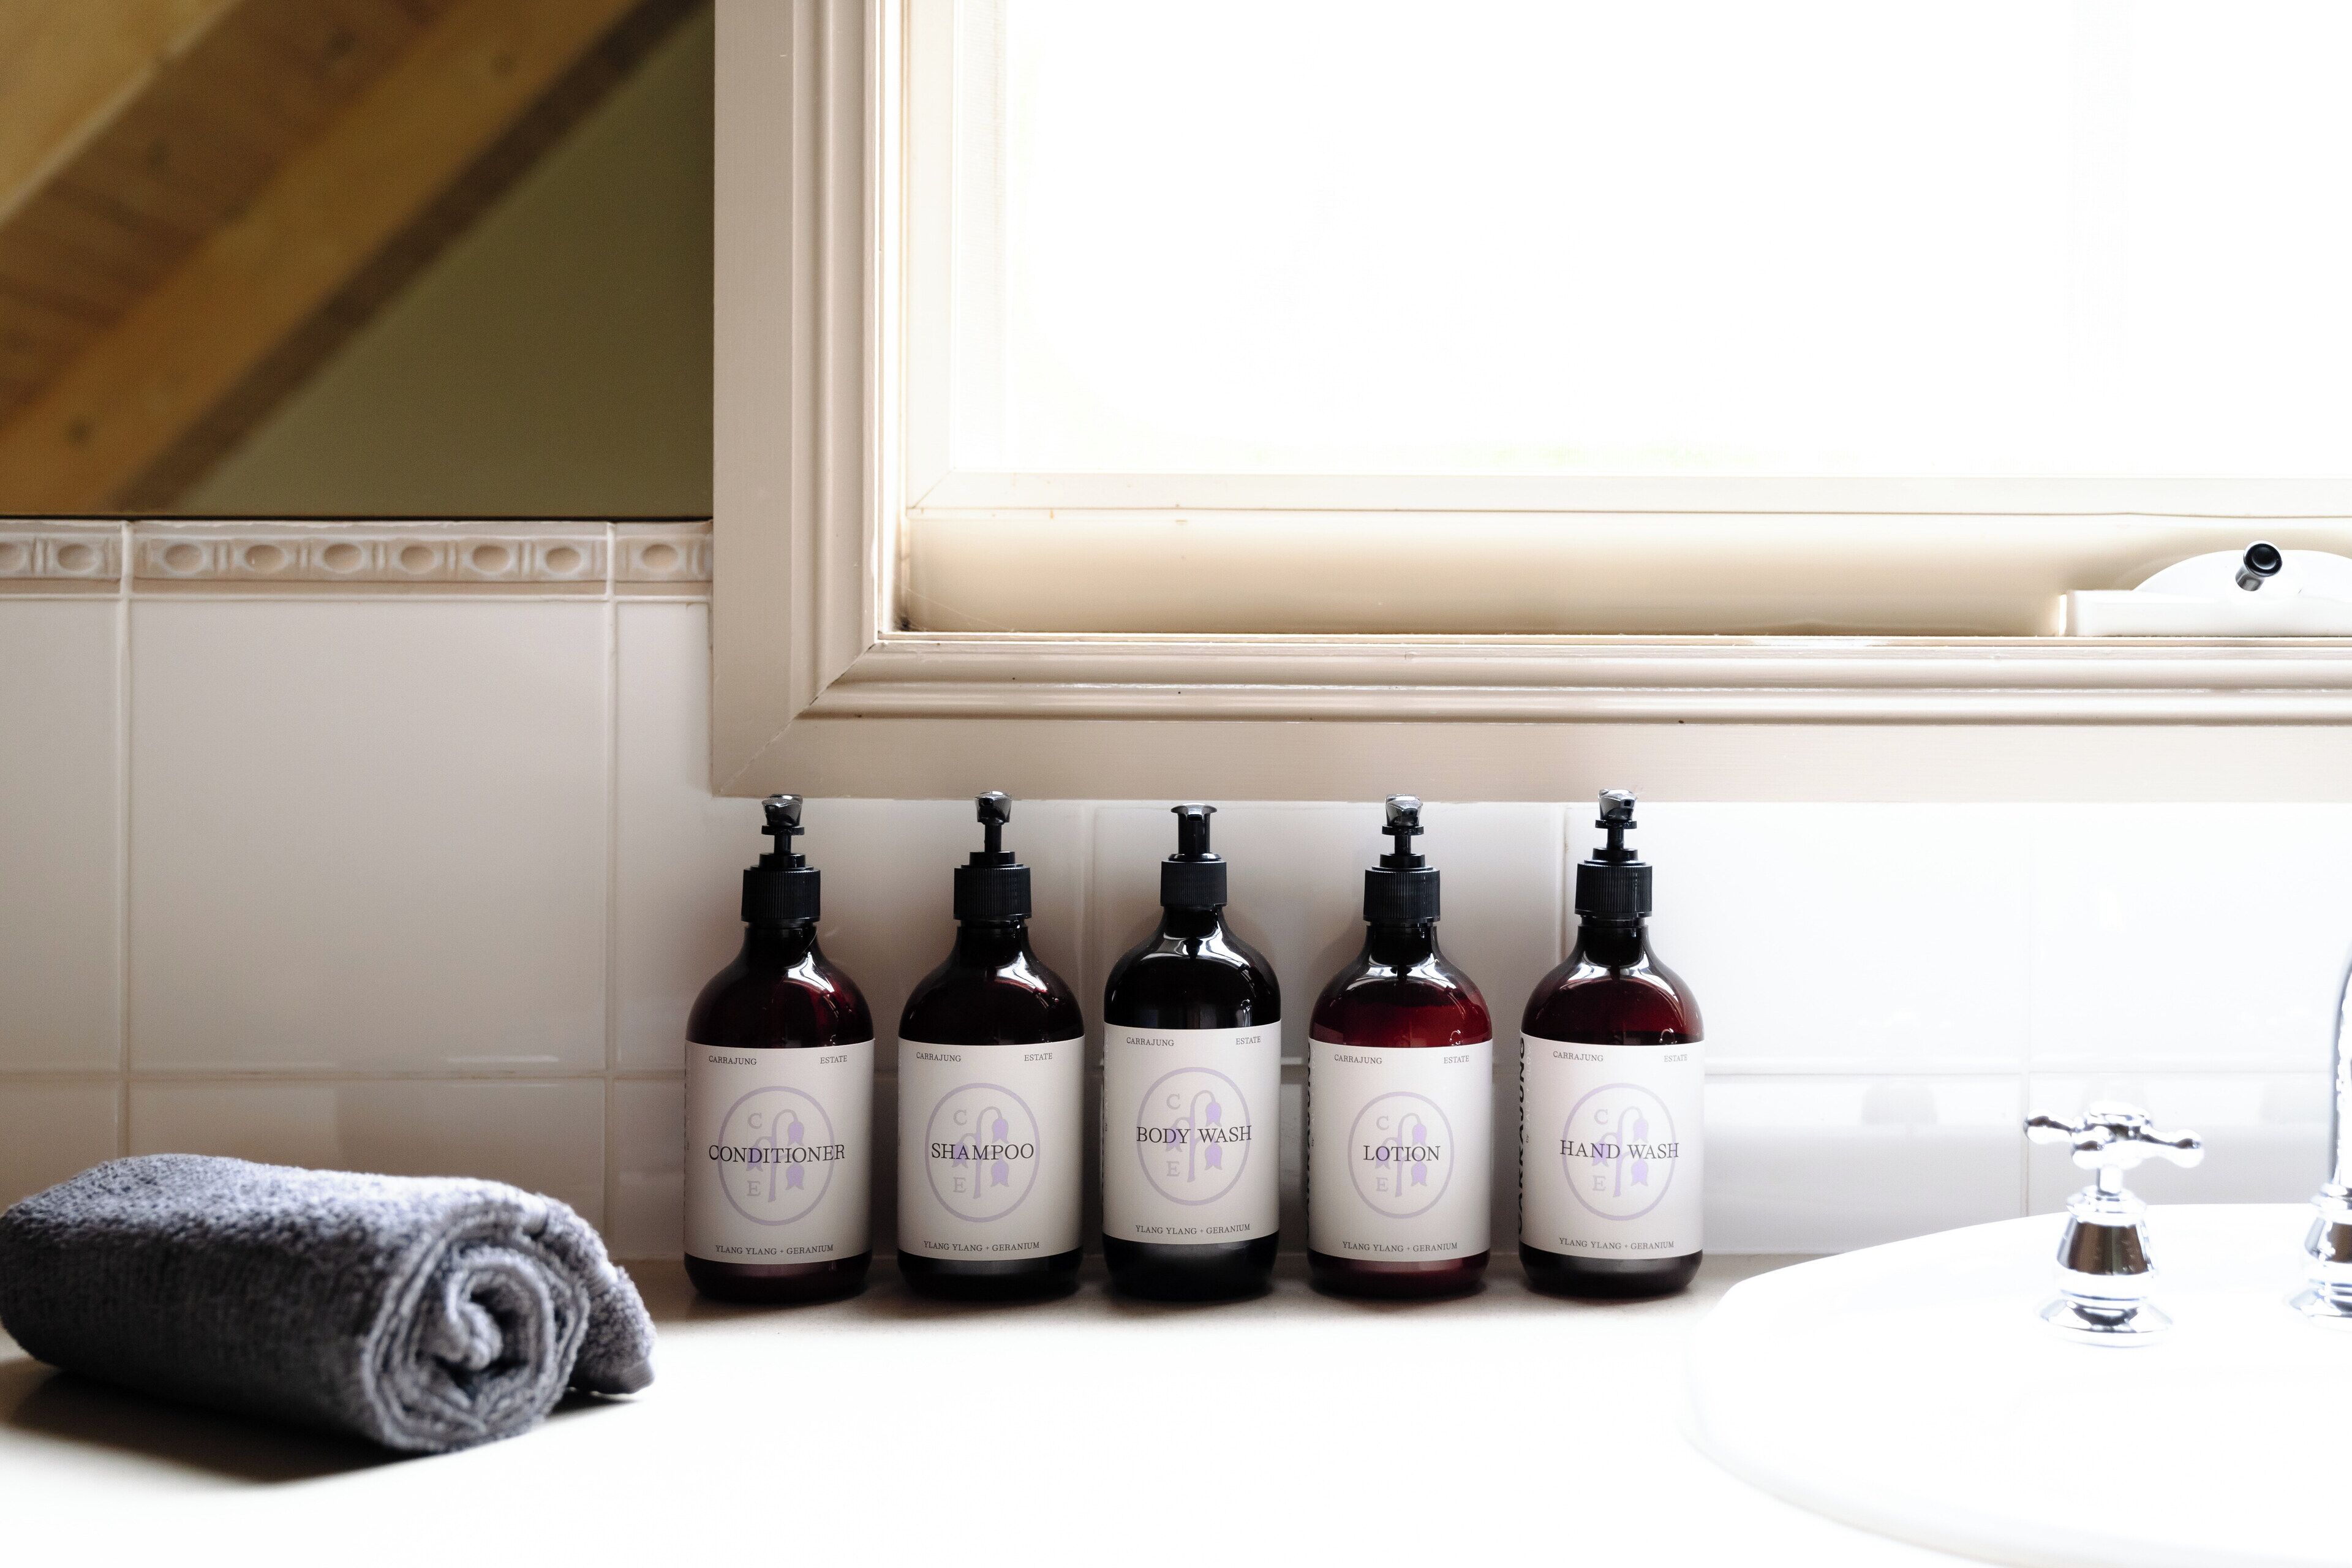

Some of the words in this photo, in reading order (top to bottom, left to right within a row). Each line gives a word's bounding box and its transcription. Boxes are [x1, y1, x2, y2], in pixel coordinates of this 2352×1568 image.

[1126, 1037, 1175, 1047] CARRAJUNG
[1235, 1036, 1261, 1045] ESTATE
[709, 1055, 757, 1065] CARRAJUNG
[820, 1055, 848, 1065] ESTATE
[916, 1052, 962, 1062] CARRAJUNG
[1024, 1052, 1053, 1061] ESTATE
[1334, 1054, 1382, 1065] CARRAJUNG
[1444, 1055, 1469, 1064] ESTATE
[1553, 1050, 1604, 1062] CARRAJUNG
[1664, 1054, 1687, 1063] ESTATE
[1136, 1126, 1191, 1144] BODY
[1197, 1125, 1252, 1144] WASH
[709, 1144, 845, 1164] CONDITIONER
[931, 1142, 1035, 1160] SHAMPOO
[1363, 1145, 1441, 1162] LOTION
[1559, 1139, 1621, 1159] HAND
[1626, 1142, 1679, 1159] WASH
[1136, 1225, 1164, 1234] YLANG
[1206, 1223, 1250, 1234] GERANIUM
[715, 1245, 744, 1254] YLANG
[786, 1244, 833, 1255] GERANIUM
[923, 1240, 950, 1250] YLANG
[952, 1243, 983, 1252] YLANG
[992, 1241, 1039, 1251] GERANIUM
[1342, 1241, 1370, 1251] YLANG
[1373, 1244, 1404, 1253] YLANG
[1412, 1242, 1458, 1252] GERANIUM
[1559, 1237, 1588, 1248] YLANG
[1590, 1241, 1621, 1250] YLANG
[1630, 1240, 1674, 1250] GERANIUM
